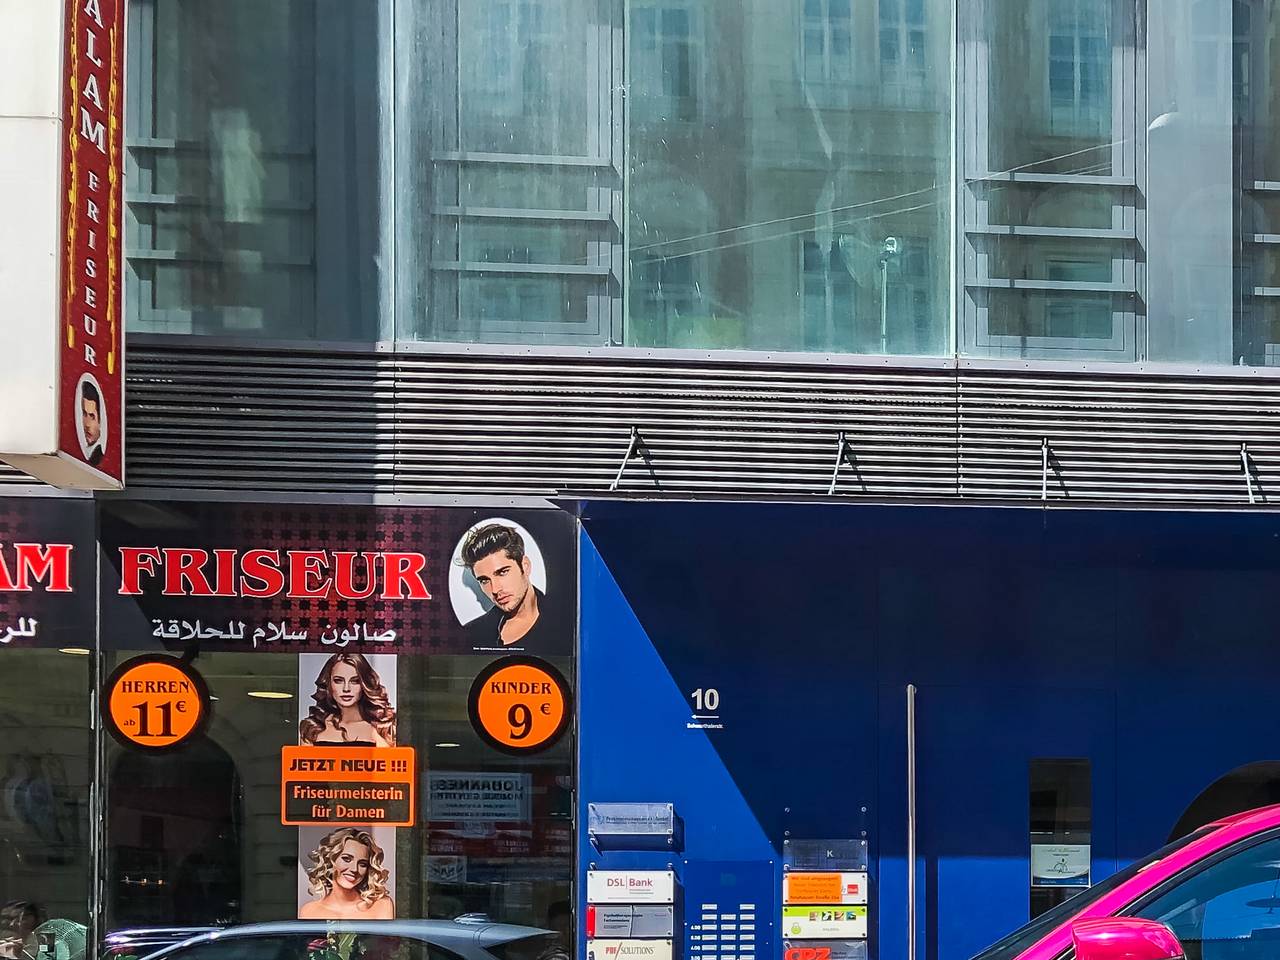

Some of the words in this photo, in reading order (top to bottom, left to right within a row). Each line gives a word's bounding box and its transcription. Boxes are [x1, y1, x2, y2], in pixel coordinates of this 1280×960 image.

[83, 170, 101, 367] FRISEUR
[117, 546, 432, 599] FRISEUR
[152, 617, 246, 642] للحلاقة
[252, 618, 308, 648] سلام
[321, 622, 397, 648] صالون
[122, 681, 190, 693] HERREN
[491, 681, 552, 695] KINDER
[691, 688, 720, 711] 10
[289, 759, 336, 772] JETZT
[340, 759, 386, 772] NEUE
[293, 785, 403, 800] Friseurmeisterin
[312, 805, 332, 818] für
[335, 805, 385, 819] Damen
[607, 878, 625, 887] DSL
[629, 878, 653, 887] Bank
